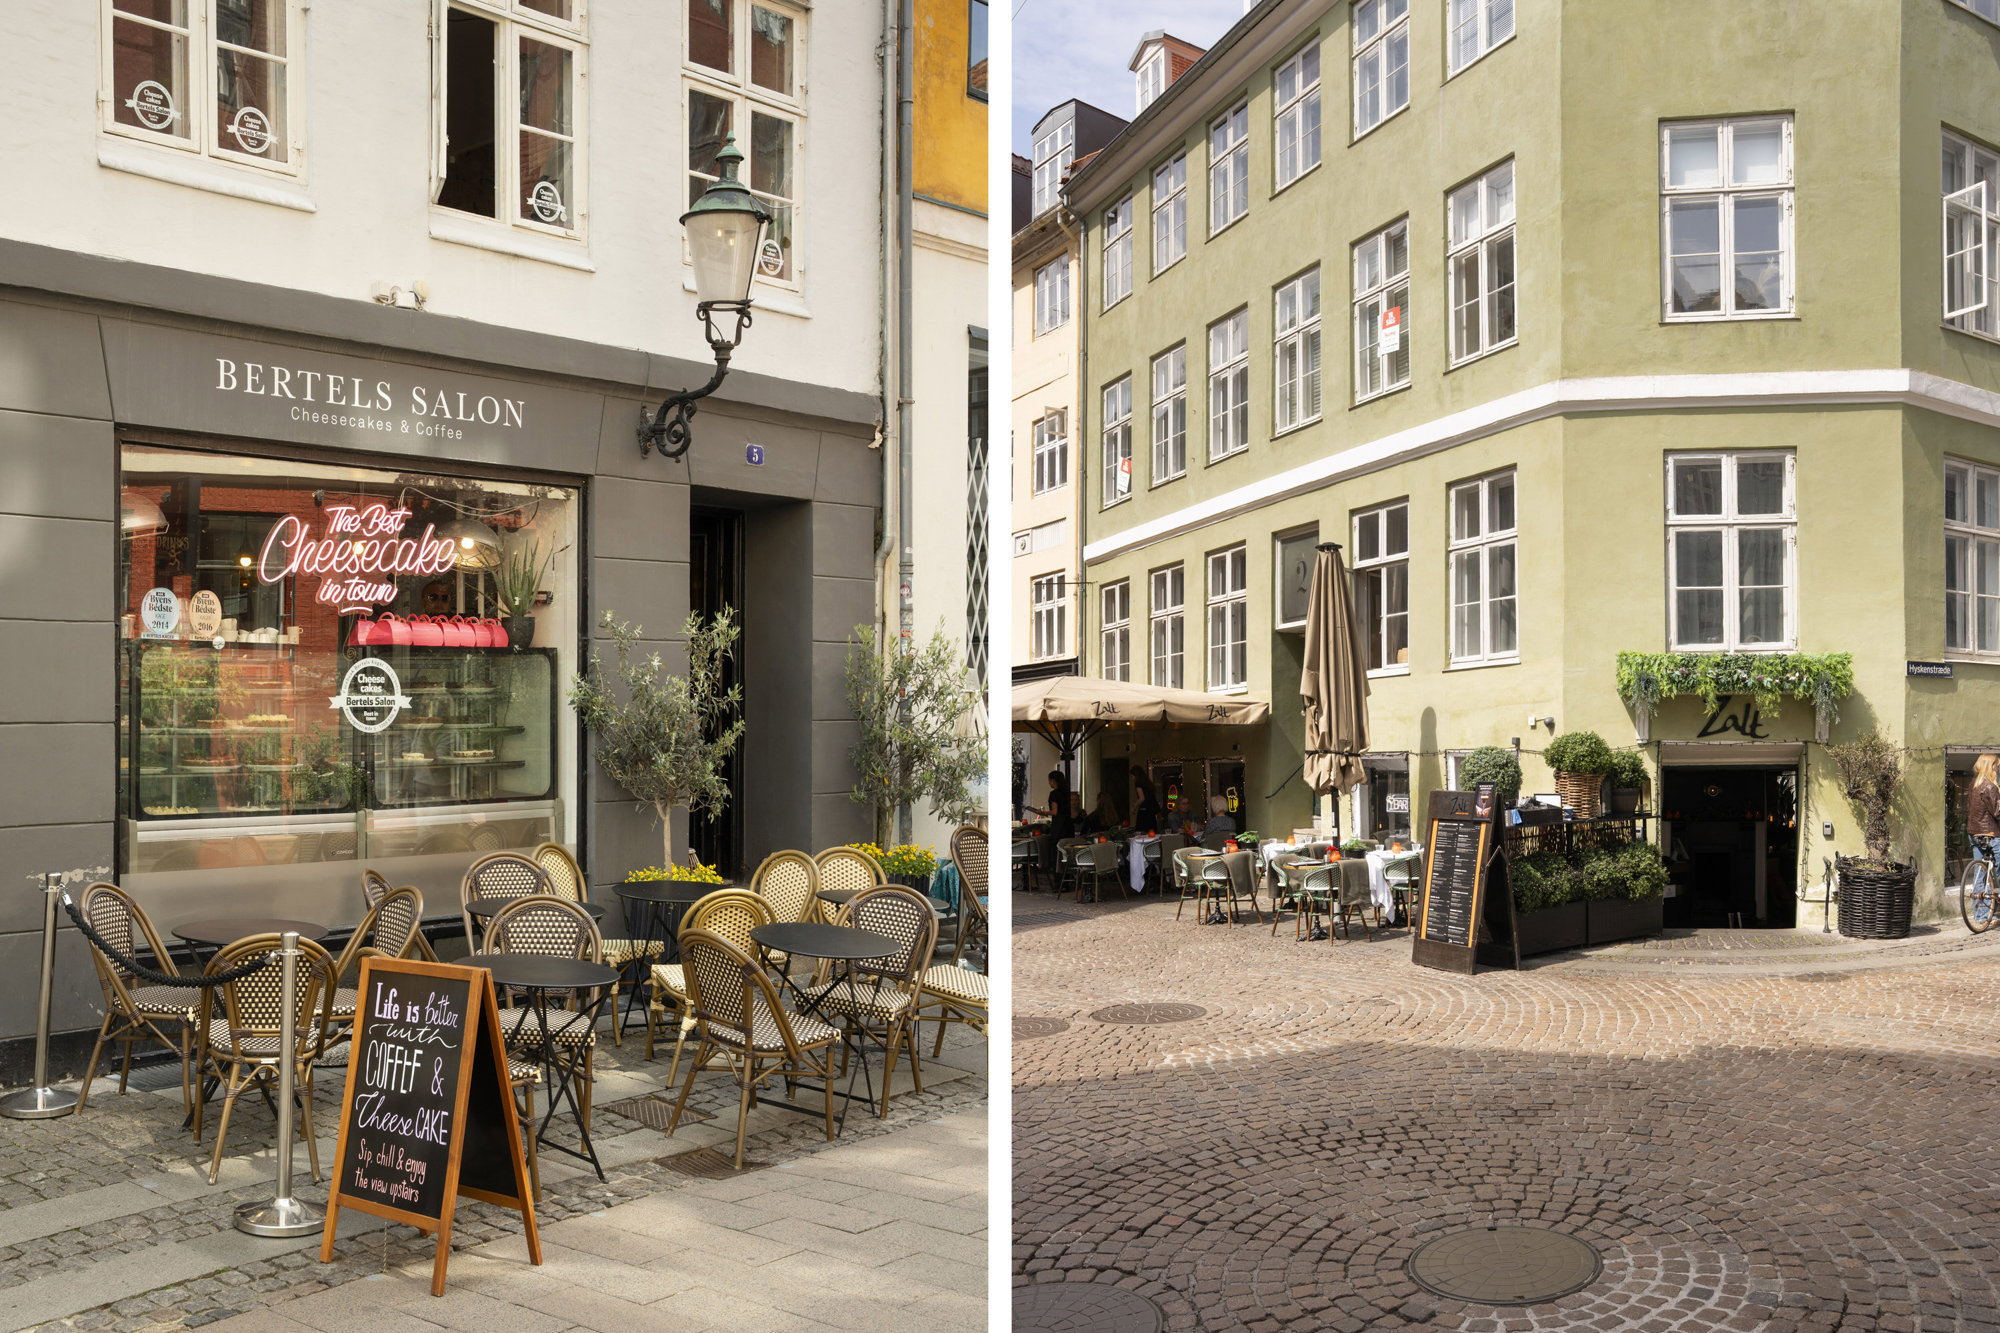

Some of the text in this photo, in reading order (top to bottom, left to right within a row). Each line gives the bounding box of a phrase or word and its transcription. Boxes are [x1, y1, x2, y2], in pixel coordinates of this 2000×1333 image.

[137, 102, 170, 115] Bertels Salon
[238, 128, 254, 137] Bertels
[216, 358, 525, 429] BERTELS SALON
[291, 406, 463, 440] Cheesecakes & Coffee
[752, 448, 759, 462] 5
[326, 504, 412, 537] The Best
[260, 516, 459, 583] Cheesecake
[320, 576, 398, 604] in town
[149, 603, 172, 612] Bedste
[150, 595, 171, 605] Byens
[196, 597, 215, 605] Byens
[196, 604, 216, 614] Bedste
[152, 621, 169, 629] 2014
[1909, 664, 1951, 674] Hyskenstræde
[358, 674, 385, 683] Cheese
[360, 683, 382, 692] cakes
[346, 697, 396, 706] Bertels Salon
[1091, 701, 1120, 717] Zalt
[1206, 704, 1230, 721] Zalt
[1696, 695, 1770, 738] Zalt
[375, 982, 458, 1028] Life is better
[369, 1023, 457, 1048] with
[431, 1056, 444, 1097] &
[376, 1143, 396, 1168] chill
[396, 1148, 404, 1170] &
[405, 1158, 427, 1185] enjoy
[355, 1167, 419, 1203] the view upstairs
